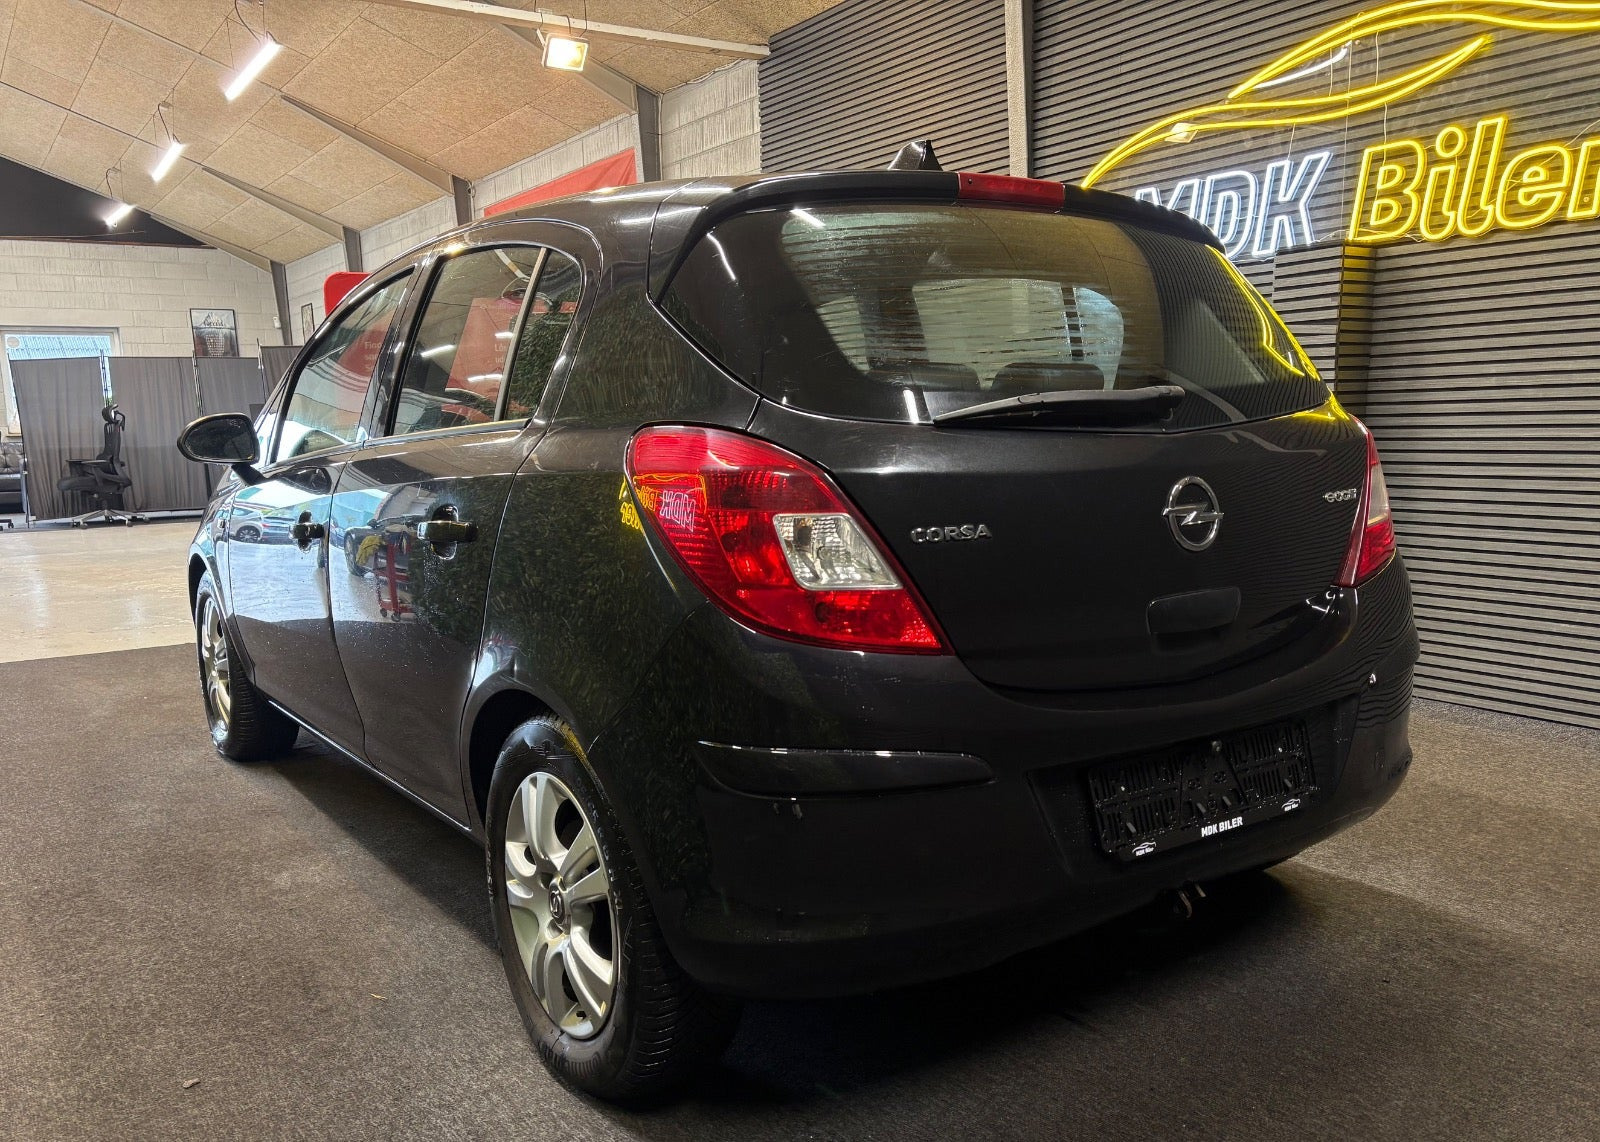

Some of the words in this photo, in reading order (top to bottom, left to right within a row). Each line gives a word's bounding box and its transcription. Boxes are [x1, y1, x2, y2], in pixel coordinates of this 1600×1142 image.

[911, 524, 992, 542] CORSA
[1201, 823, 1218, 837] MDK
[1218, 816, 1243, 832] BILER
